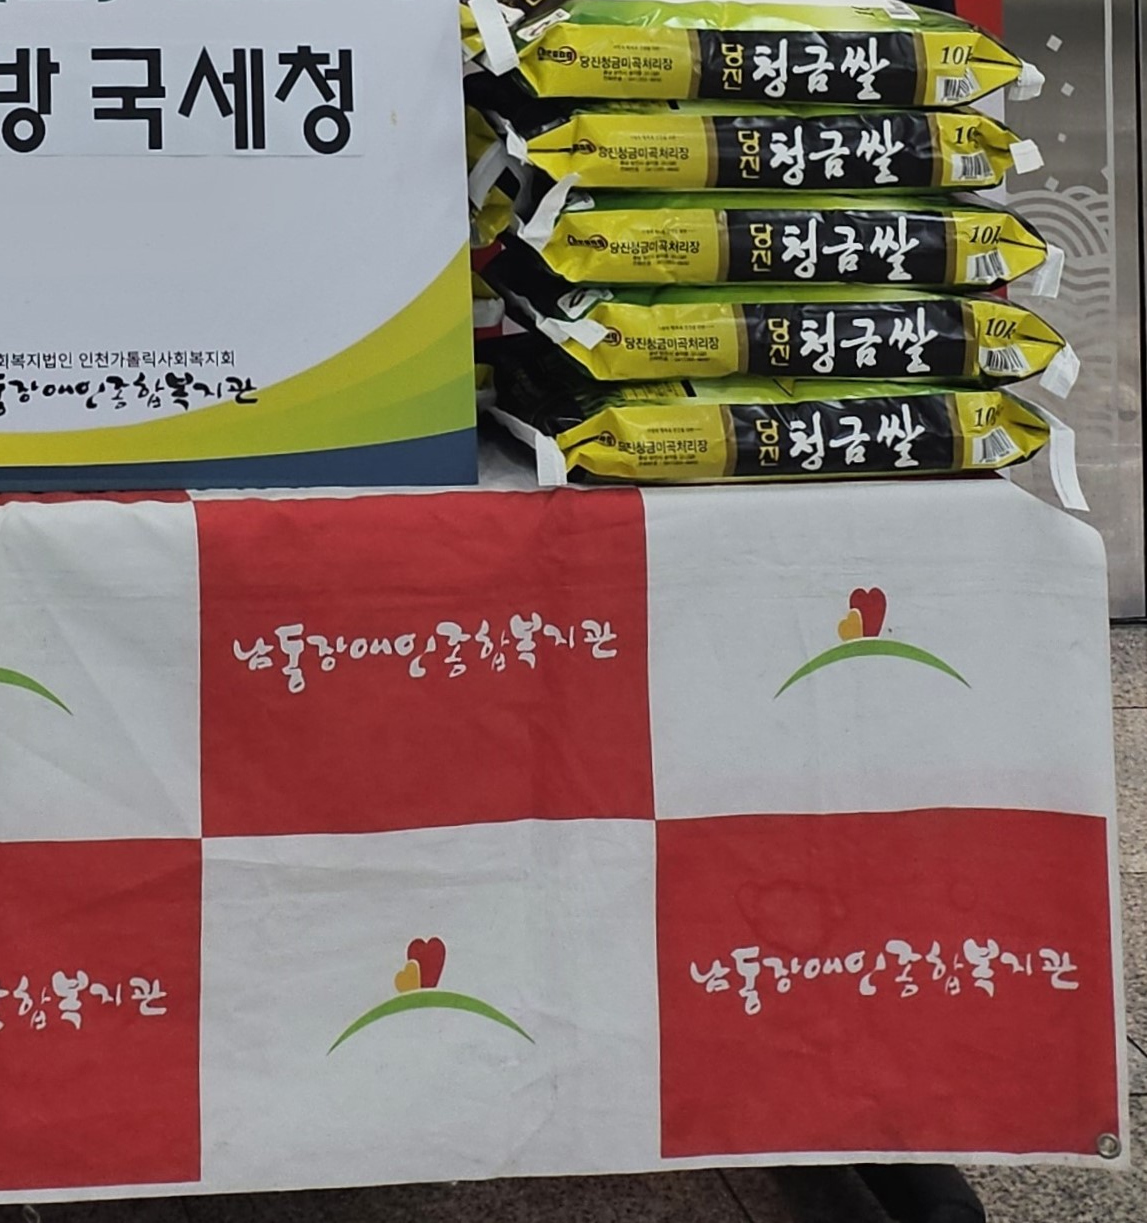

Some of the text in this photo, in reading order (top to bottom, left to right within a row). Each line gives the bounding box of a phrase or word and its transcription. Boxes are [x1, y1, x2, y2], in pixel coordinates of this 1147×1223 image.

[580, 55, 673, 70] 당진청금미곡처리장
[752, 37, 890, 100] 청금쌀
[91, 44, 356, 154] 국세청
[769, 119, 905, 186] 청금쌀
[781, 216, 920, 281] 청금쌀
[79, 350, 236, 369] 인천가톨릭사회복지회
[800, 306, 939, 373] 청금쌀
[788, 403, 926, 470] 청금쌀
[233, 612, 619, 693] 남동장애인종합복지관
[690, 939, 1080, 1015] 남동장애인종합복지관
